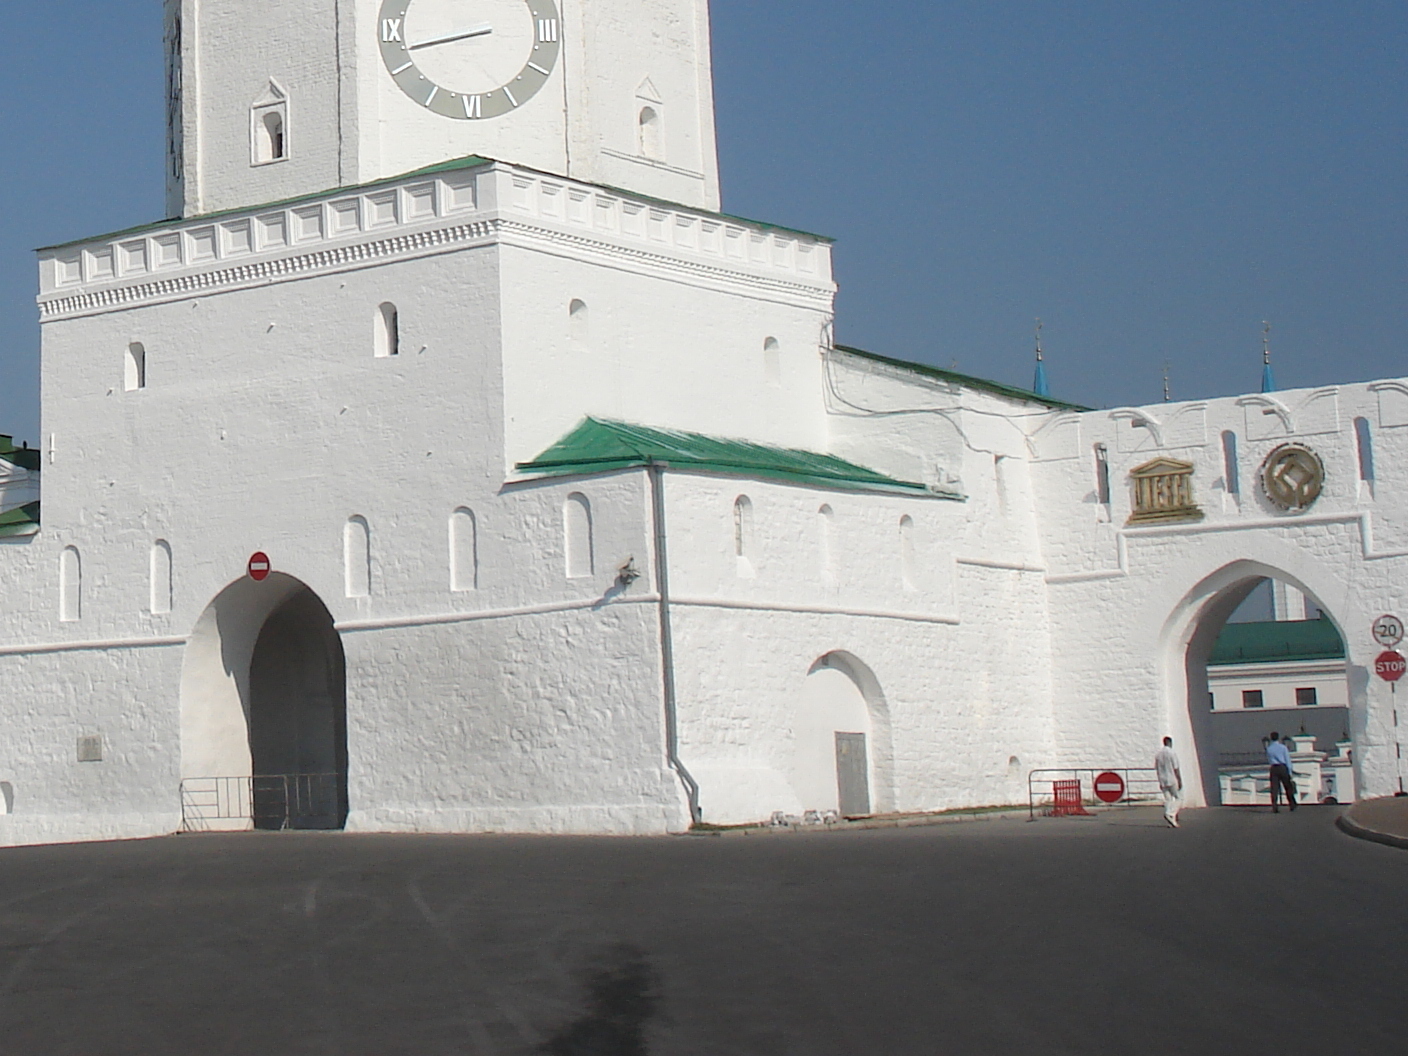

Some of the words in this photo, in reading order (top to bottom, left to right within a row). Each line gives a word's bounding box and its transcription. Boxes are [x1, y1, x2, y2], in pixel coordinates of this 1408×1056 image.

[382, 19, 401, 42] IX
[538, 19, 557, 42] III
[462, 95, 482, 118] VI
[1380, 625, 1397, 637] 20
[1376, 661, 1406, 673] STOP
